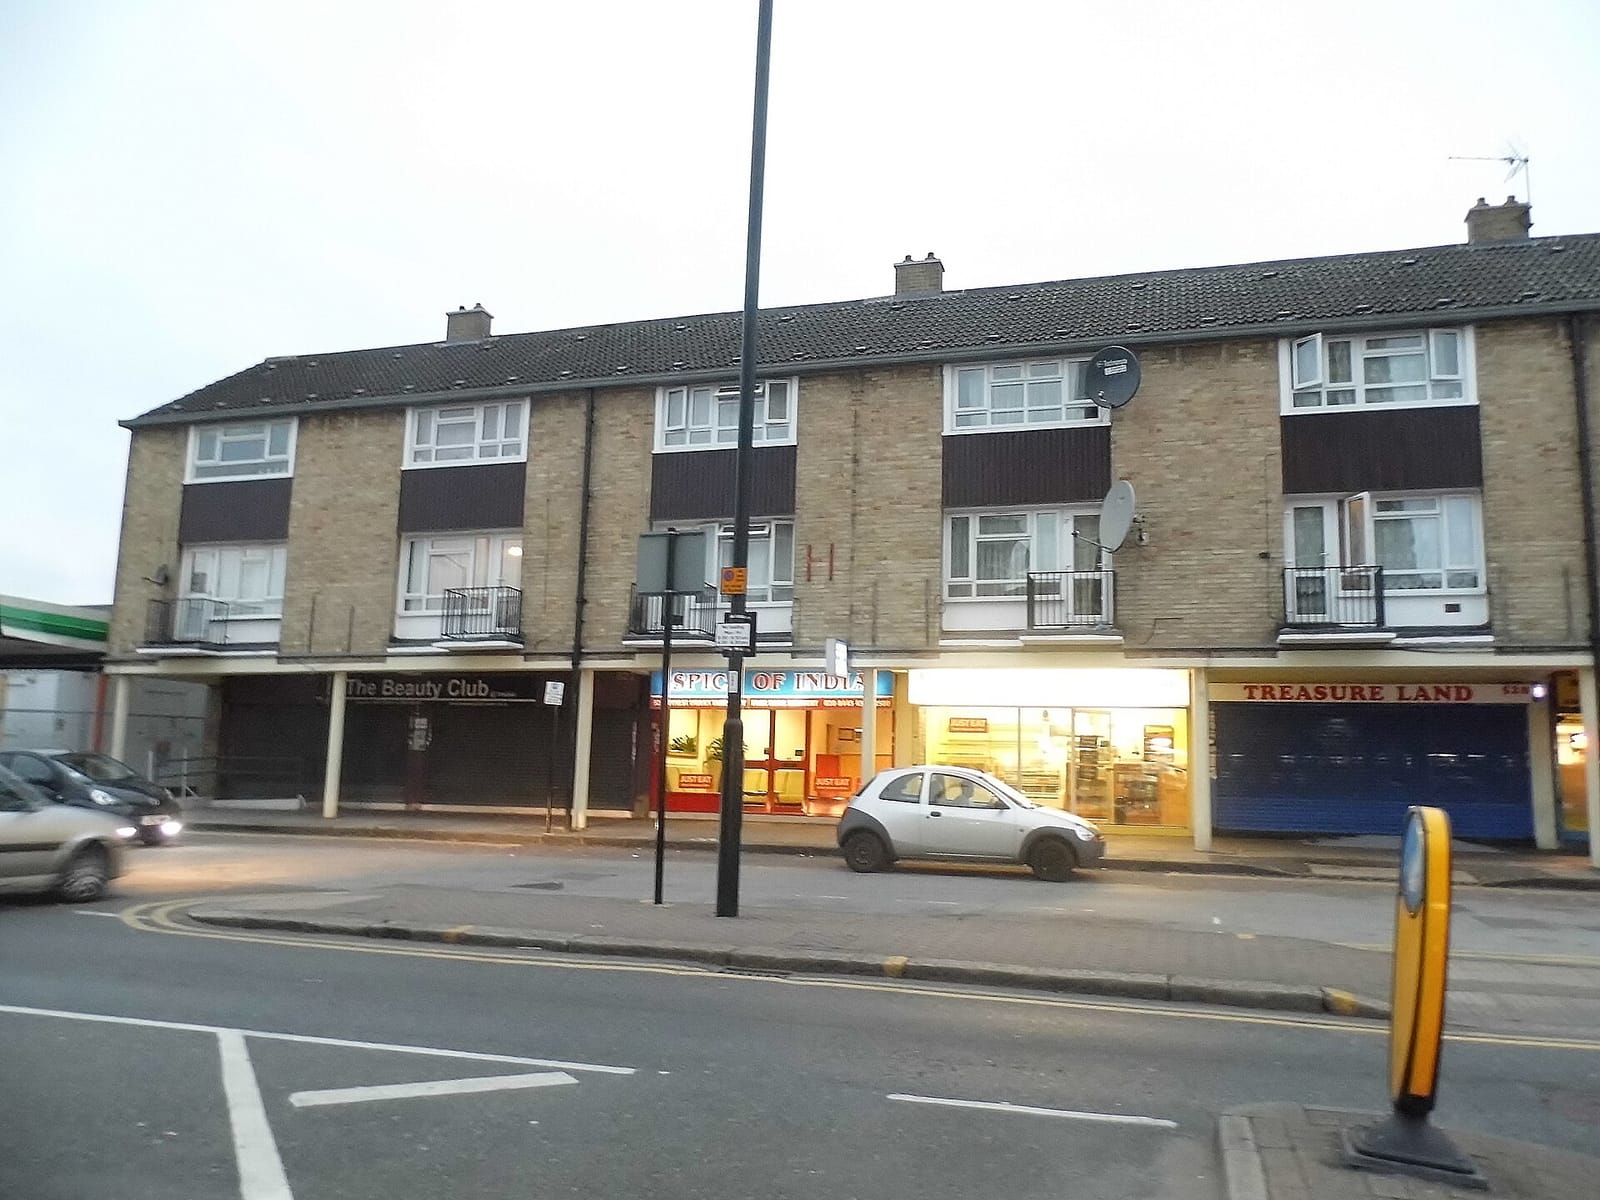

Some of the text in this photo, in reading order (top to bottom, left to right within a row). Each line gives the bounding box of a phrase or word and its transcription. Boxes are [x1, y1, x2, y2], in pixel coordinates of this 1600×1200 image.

[346, 678, 490, 698] The Beauty Club
[672, 673, 728, 691] SPIC
[753, 672, 786, 691] OF
[1243, 684, 1474, 701] TREASURE LAND
